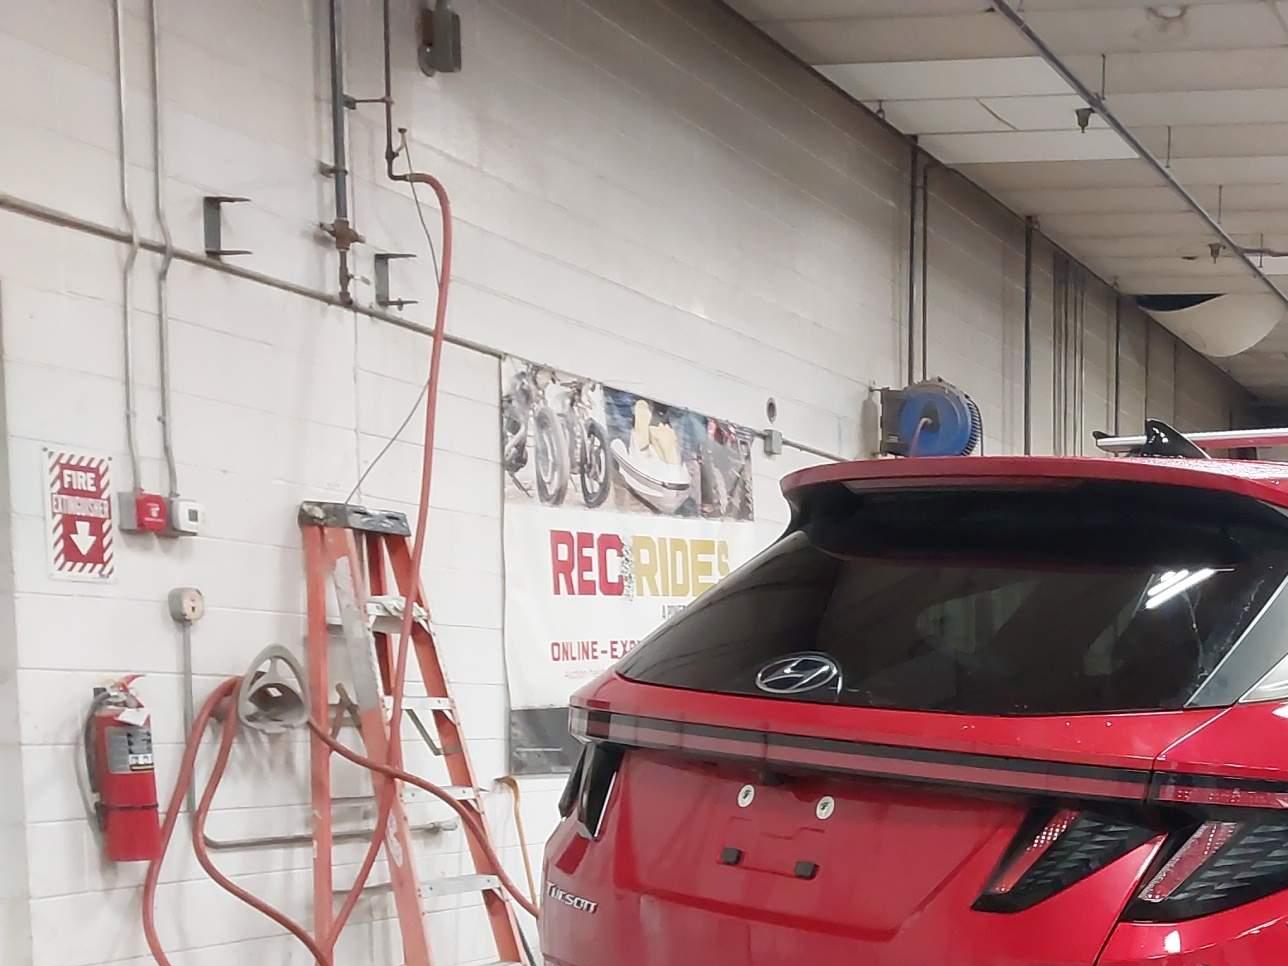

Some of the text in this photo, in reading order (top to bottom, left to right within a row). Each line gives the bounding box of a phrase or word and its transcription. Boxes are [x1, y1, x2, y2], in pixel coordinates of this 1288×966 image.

[62, 469, 97, 491] FIRE
[550, 530, 730, 597] REC RIDES
[550, 640, 642, 662] ONLINE-EXP
